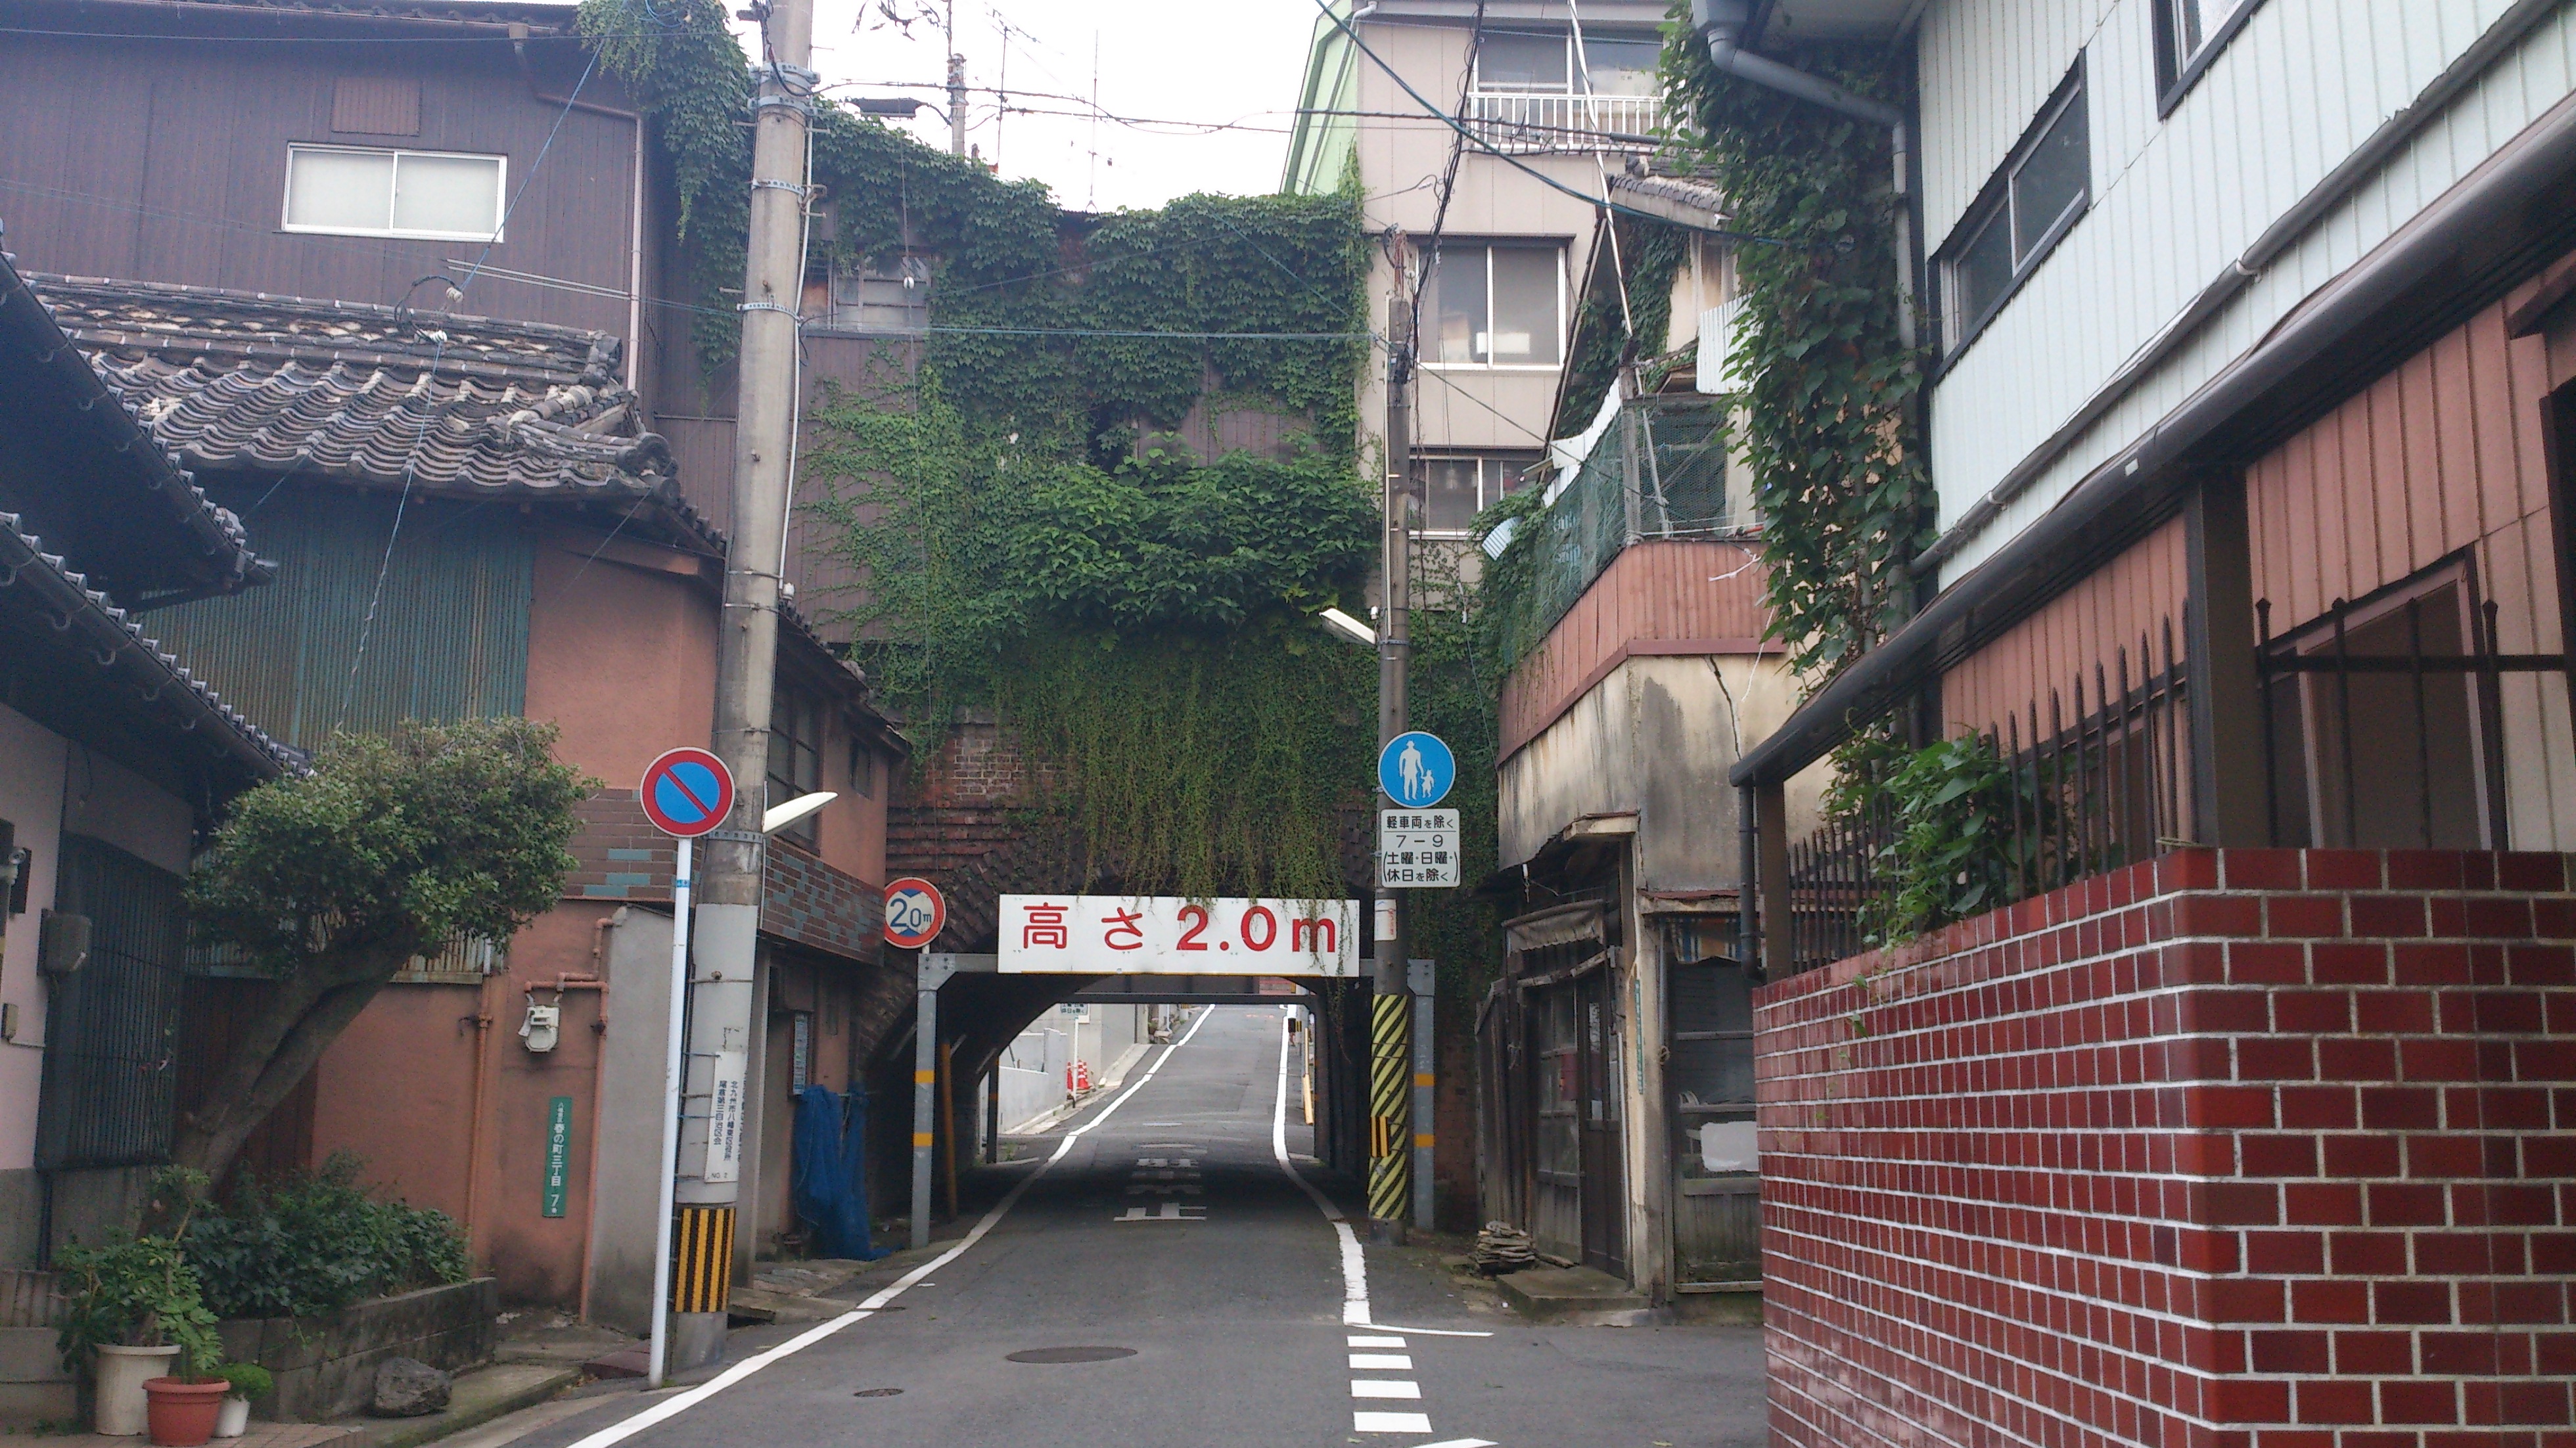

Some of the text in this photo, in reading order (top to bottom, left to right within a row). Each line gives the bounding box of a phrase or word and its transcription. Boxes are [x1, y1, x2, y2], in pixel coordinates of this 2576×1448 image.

[1387, 815, 1454, 829] 軽車両を除く
